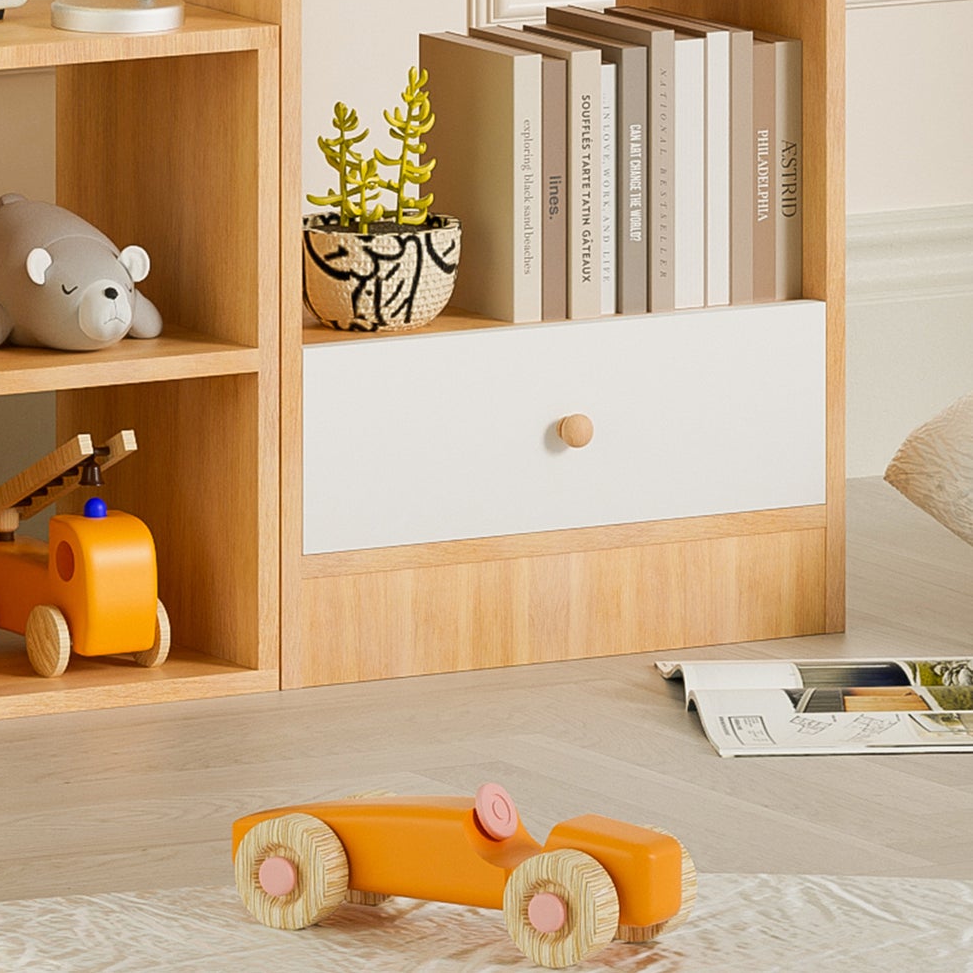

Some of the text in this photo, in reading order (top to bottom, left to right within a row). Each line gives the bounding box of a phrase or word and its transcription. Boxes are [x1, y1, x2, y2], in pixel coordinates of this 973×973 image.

[520, 119, 534, 275] exploring black sand beaches
[549, 175, 562, 220] lines.
[581, 94, 593, 283] SOUFFLÉS TARTE TATIN GÂTEAUX
[629, 124, 642, 242] CAN ART CHANGE THE WORLD?
[659, 68, 668, 278] NATIONAL BESTSELLER
[757, 129, 769, 222] PHILADELPHIA
[781, 139, 798, 218] ÆSTRID
[602, 216, 611, 243] AND
